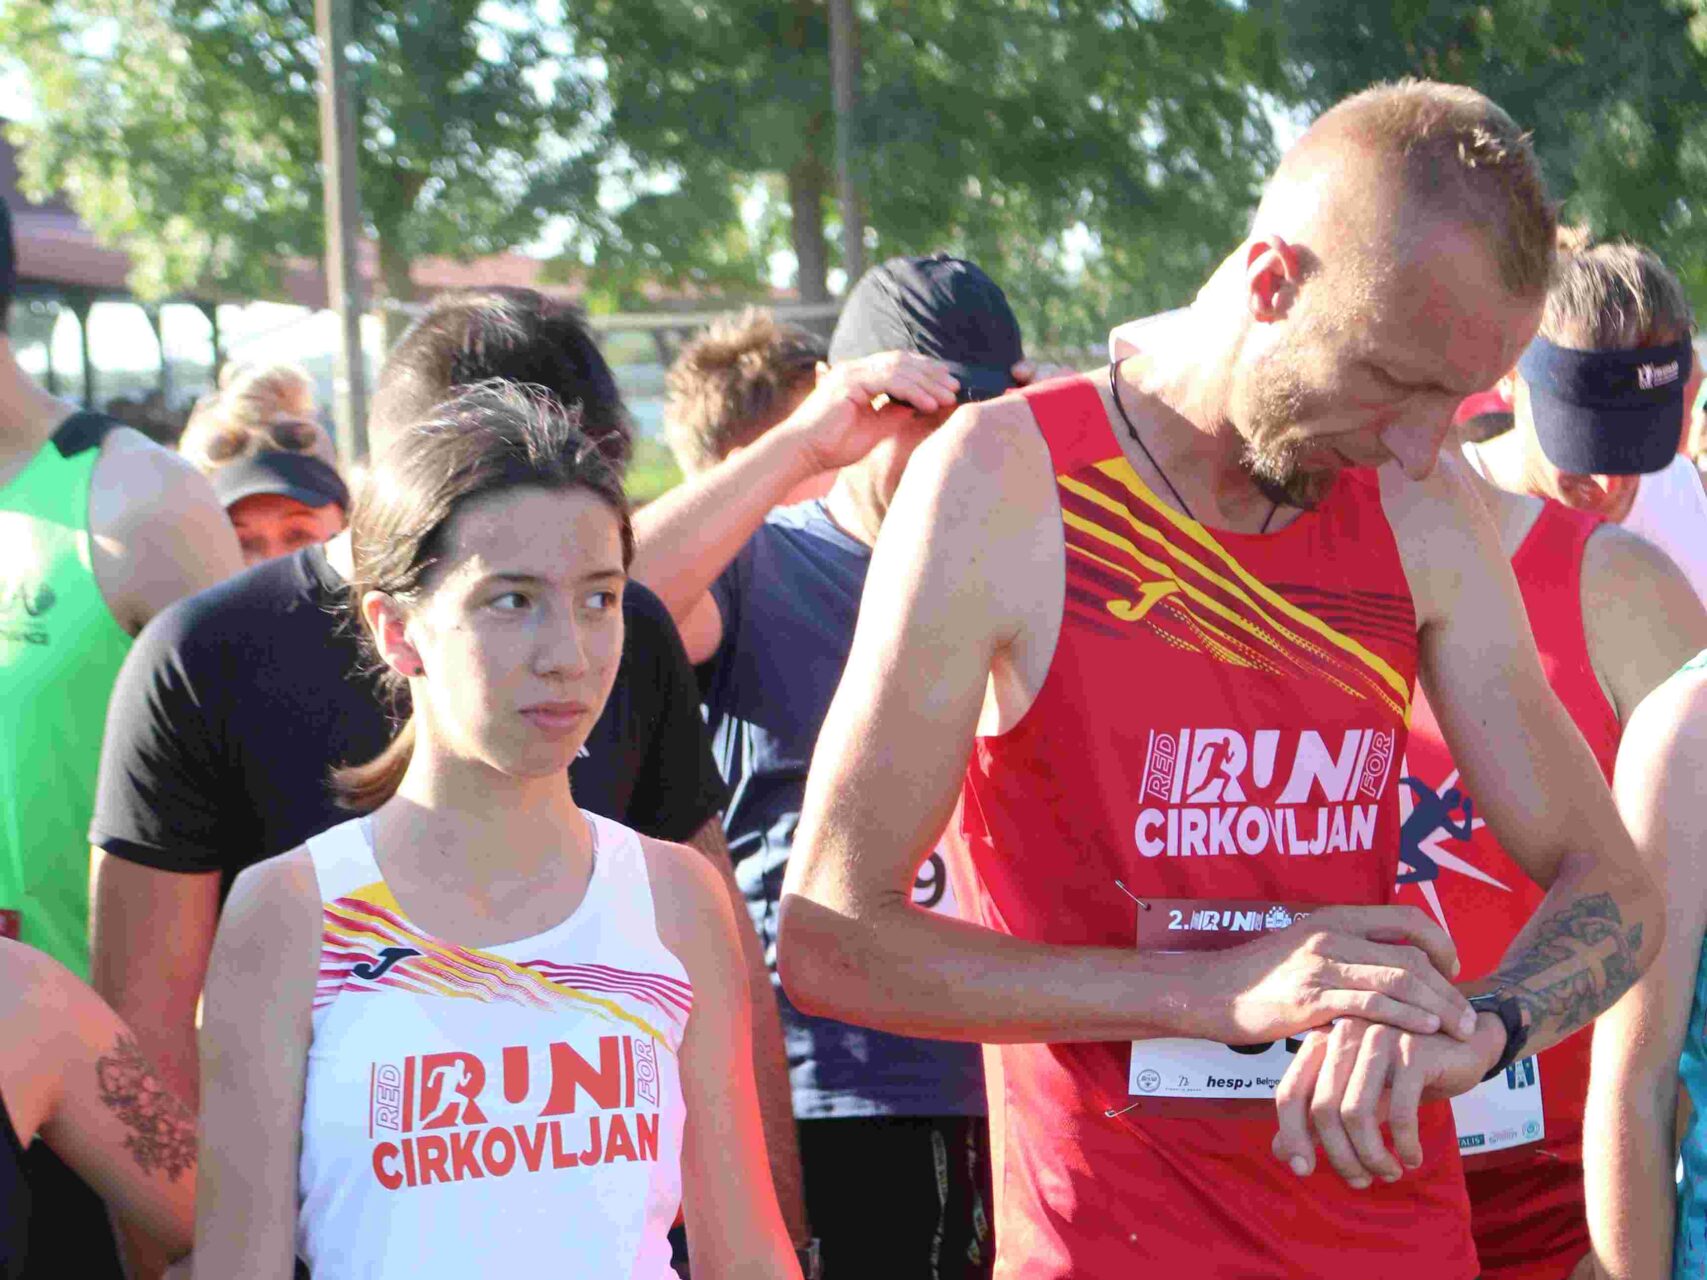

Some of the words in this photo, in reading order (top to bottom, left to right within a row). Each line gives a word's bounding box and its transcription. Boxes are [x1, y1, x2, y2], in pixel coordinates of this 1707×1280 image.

[1147, 733, 1176, 801] RED
[1187, 728, 1363, 804] RUN
[1359, 731, 1391, 798] FOR
[1133, 803, 1379, 858] CIRKOVLJAN
[376, 1064, 401, 1130] RED
[419, 1035, 623, 1132] RUN
[634, 1038, 656, 1105] FOR
[372, 1112, 660, 1191] CIRKOVLJAN
